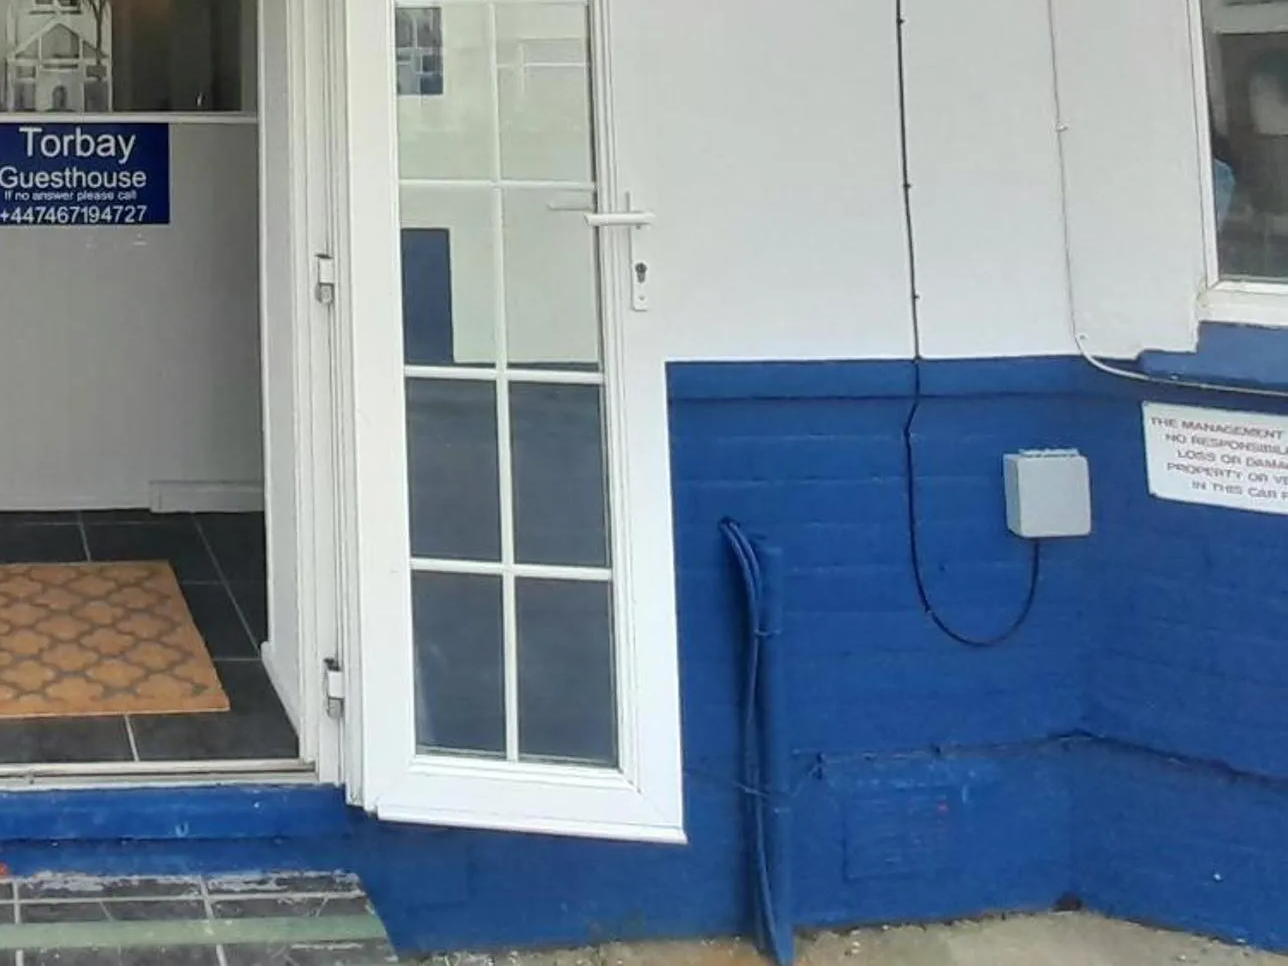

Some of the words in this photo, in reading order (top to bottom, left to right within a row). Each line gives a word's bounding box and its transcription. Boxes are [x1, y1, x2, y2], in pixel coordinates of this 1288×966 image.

[19, 126, 136, 165] Torbay
[4, 190, 12, 201] If
[14, 191, 30, 201] no
[32, 191, 74, 201] answer
[76, 190, 114, 202] please
[117, 190, 137, 200] call
[0, 205, 148, 224] +447467194727
[1151, 417, 1177, 428] THE
[1182, 420, 1284, 439] MANAGEMENT
[1165, 433, 1187, 444] NO
[1177, 450, 1216, 462] LOSS
[1220, 454, 1241, 465] OR
[1167, 462, 1243, 480] PROPERTY
[1247, 473, 1269, 483] OR
[1192, 480, 1207, 490] IN
[1213, 482, 1243, 495] THIS
[1247, 487, 1277, 499] CAR
